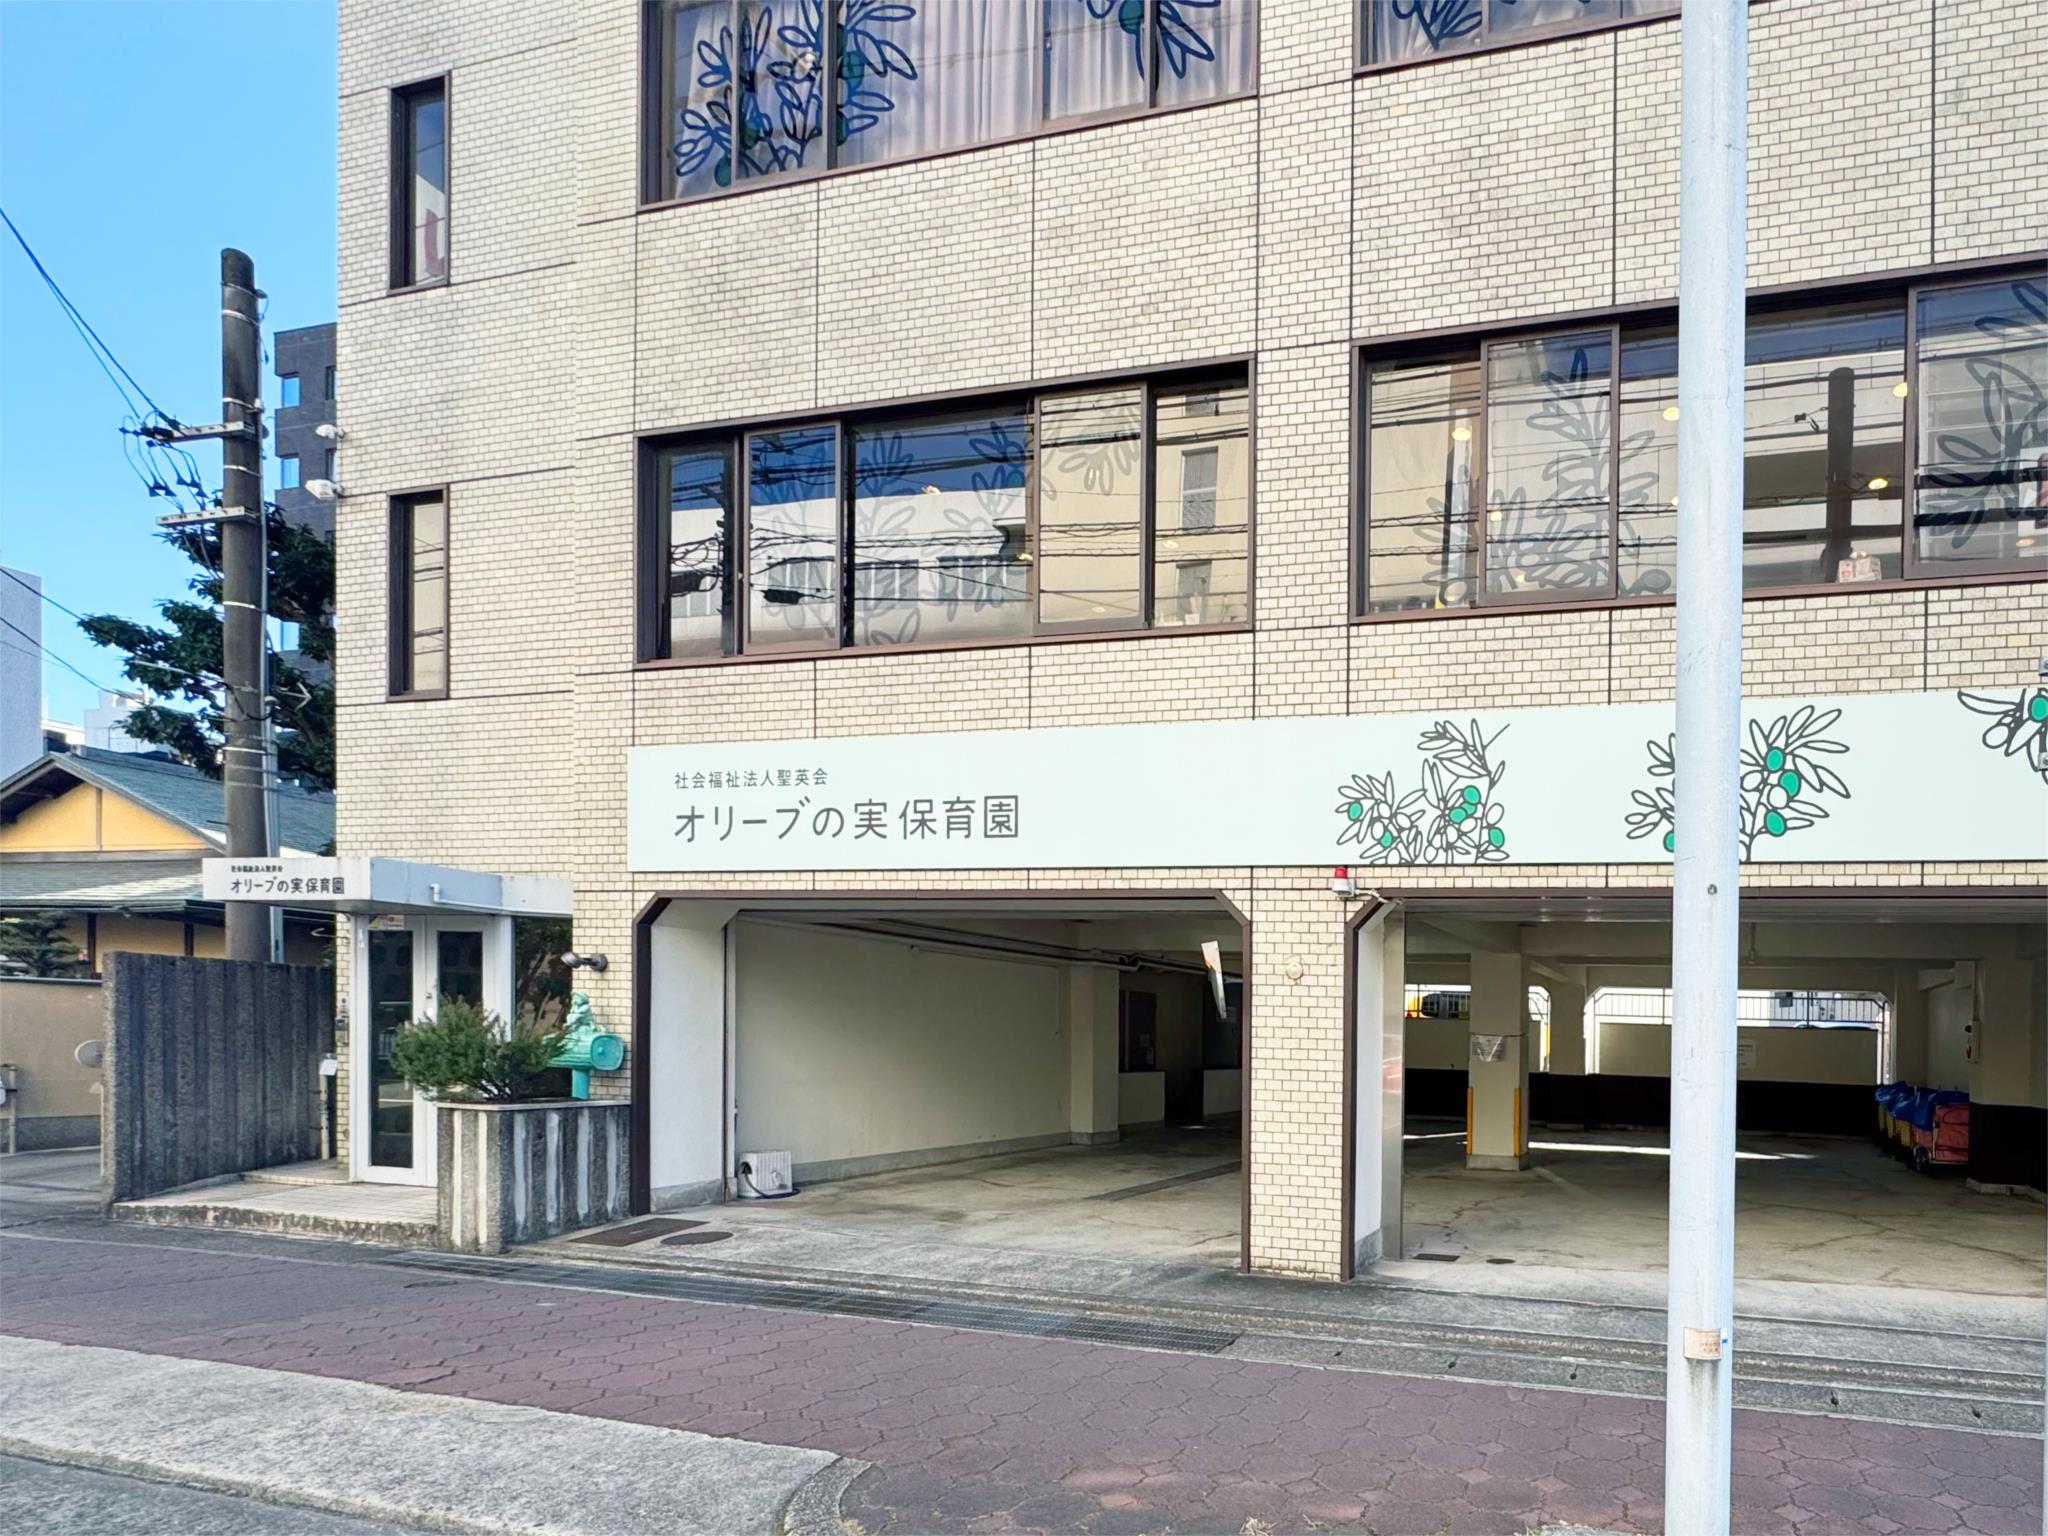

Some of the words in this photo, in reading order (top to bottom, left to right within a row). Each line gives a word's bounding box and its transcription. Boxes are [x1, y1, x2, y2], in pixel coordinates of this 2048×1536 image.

[674, 767, 828, 790] 社会福祉法人聖英会
[674, 795, 1019, 843] オリーブの実保育園
[231, 876, 345, 895] オリーブの実保育園
